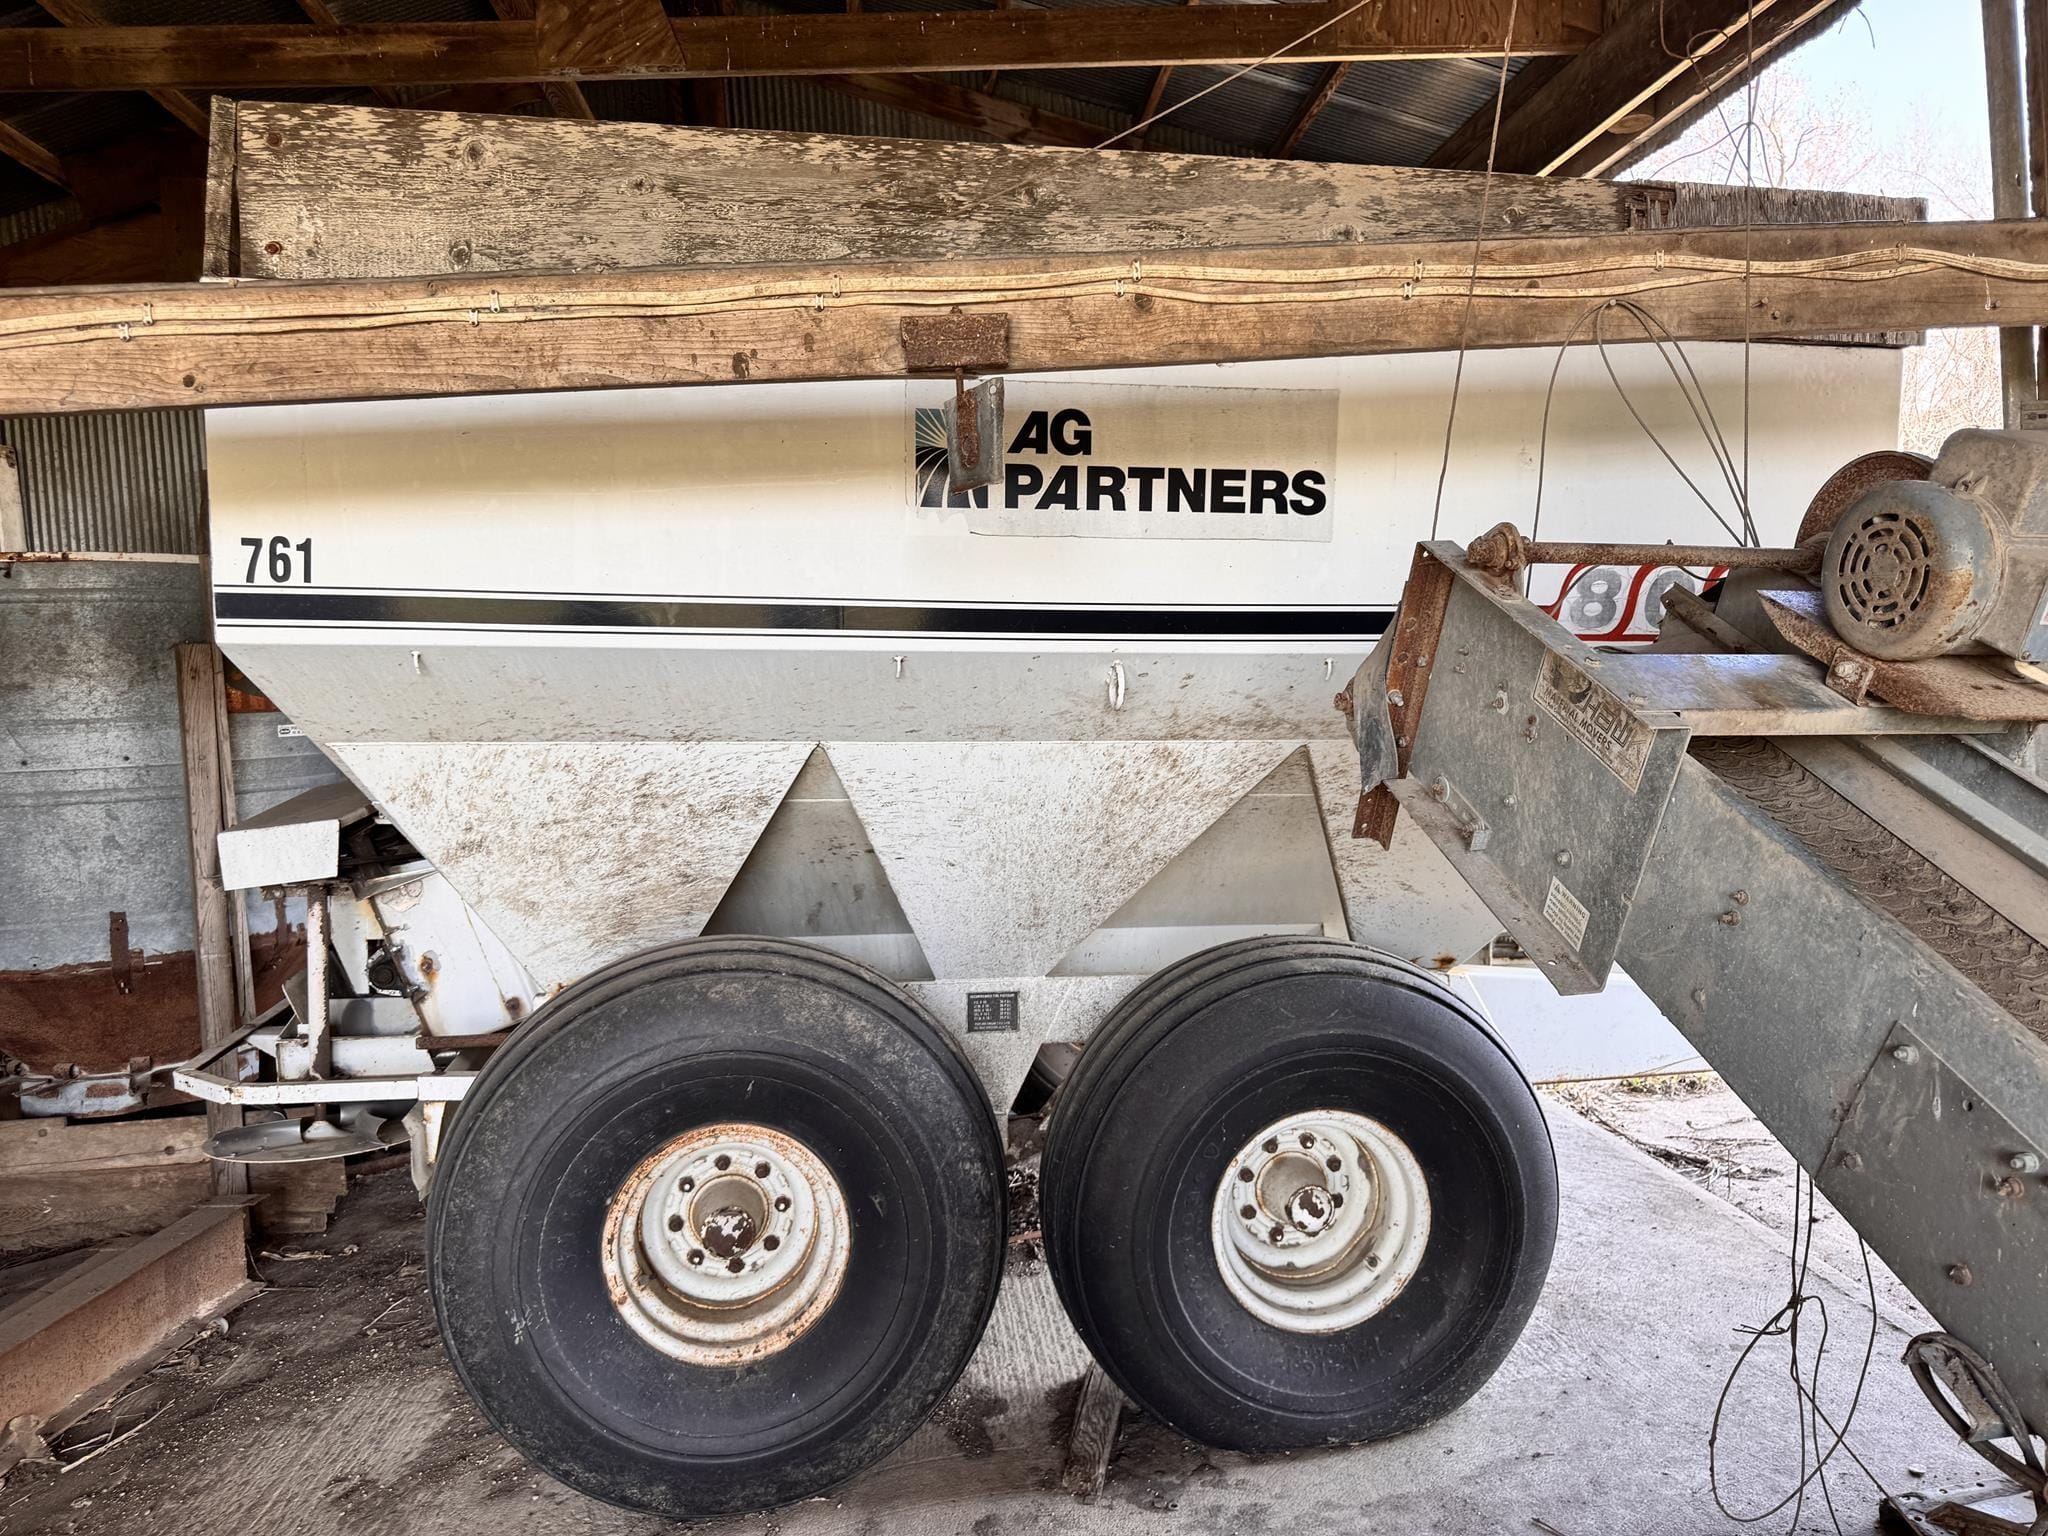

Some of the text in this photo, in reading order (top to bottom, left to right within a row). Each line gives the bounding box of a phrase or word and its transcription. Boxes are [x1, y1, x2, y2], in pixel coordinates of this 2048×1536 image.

[1006, 407, 1093, 457] AG
[1003, 462, 1328, 517] PARTNERS
[240, 535, 313, 584] 761
[1579, 719, 1613, 751] MOVERS
